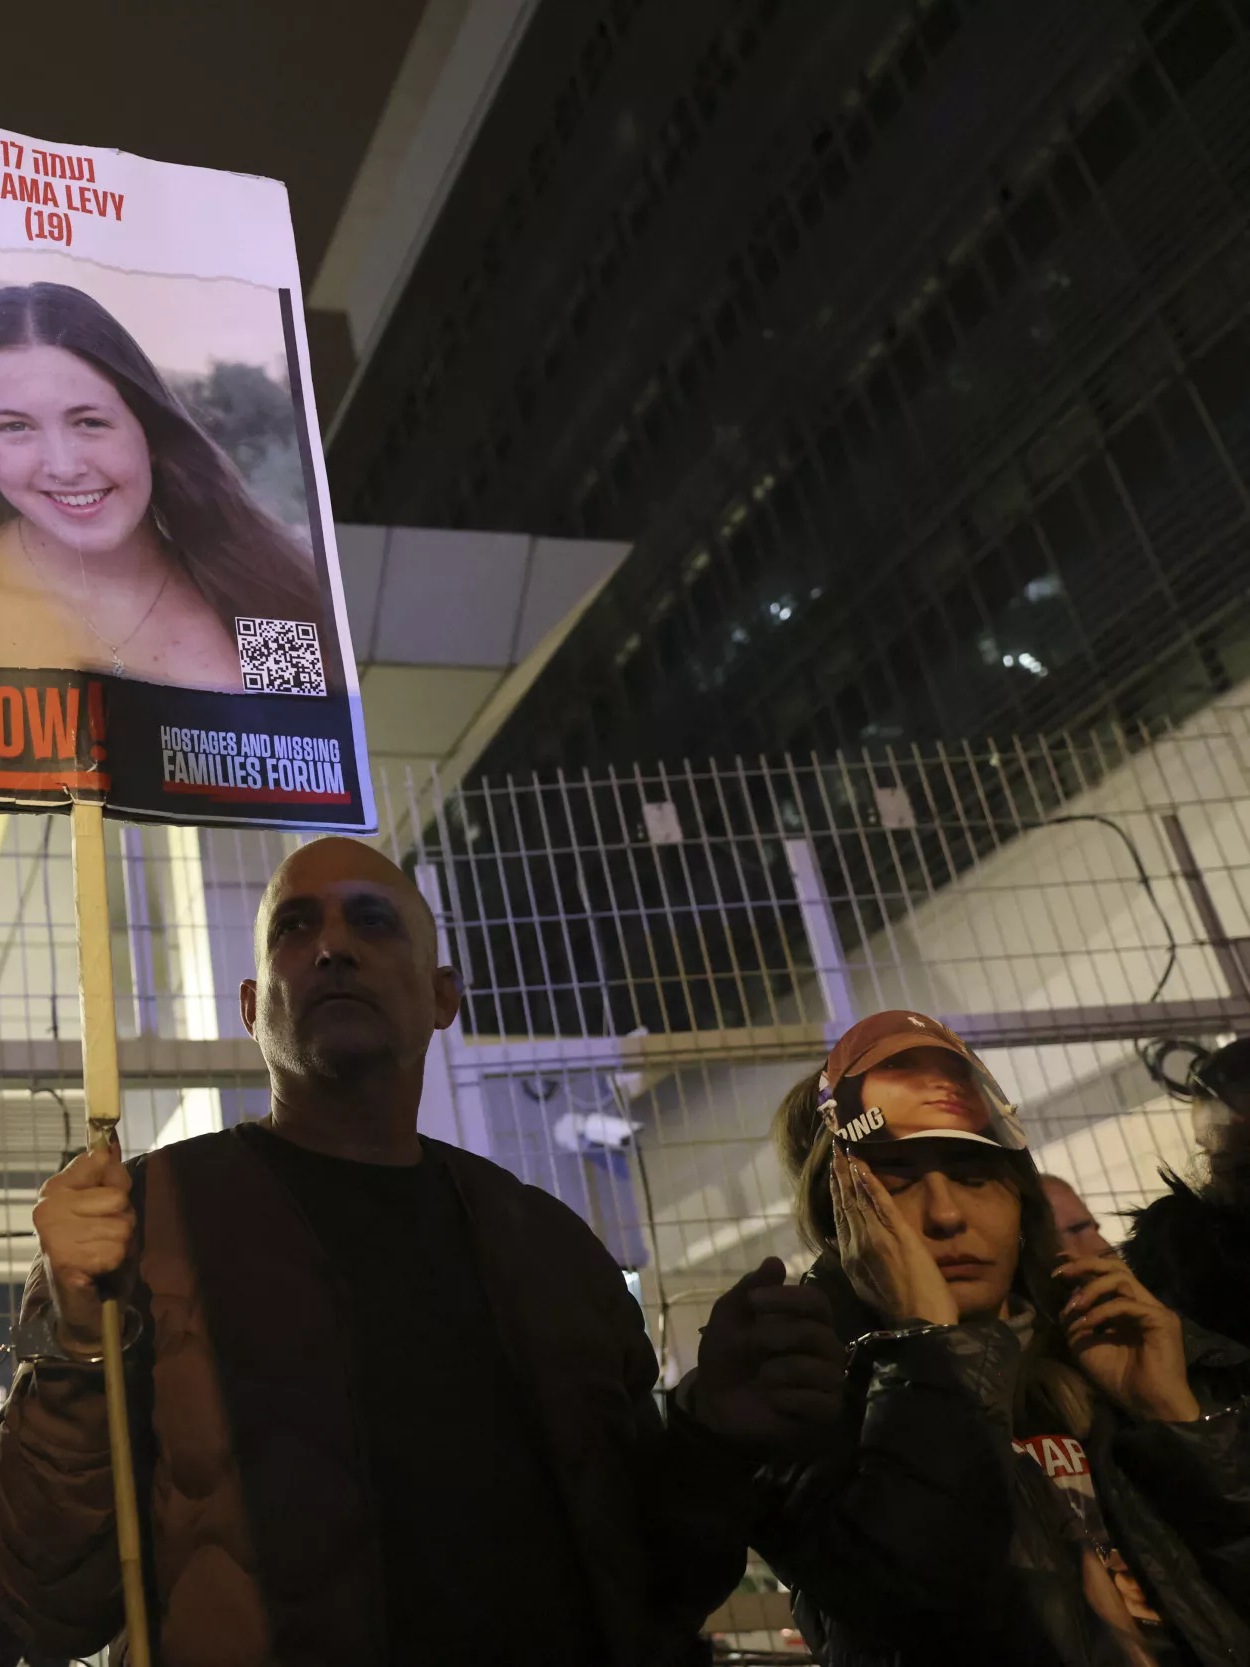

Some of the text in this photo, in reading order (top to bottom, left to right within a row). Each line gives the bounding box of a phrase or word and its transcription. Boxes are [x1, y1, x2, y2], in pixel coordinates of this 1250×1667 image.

[31, 149, 96, 184] נעמה
[65, 184, 125, 221] LEVY
[25, 206, 73, 246] (19)
[160, 725, 340, 763] HOSTAGES AND MISSING
[162, 750, 346, 794] FAMILIES FORUM
